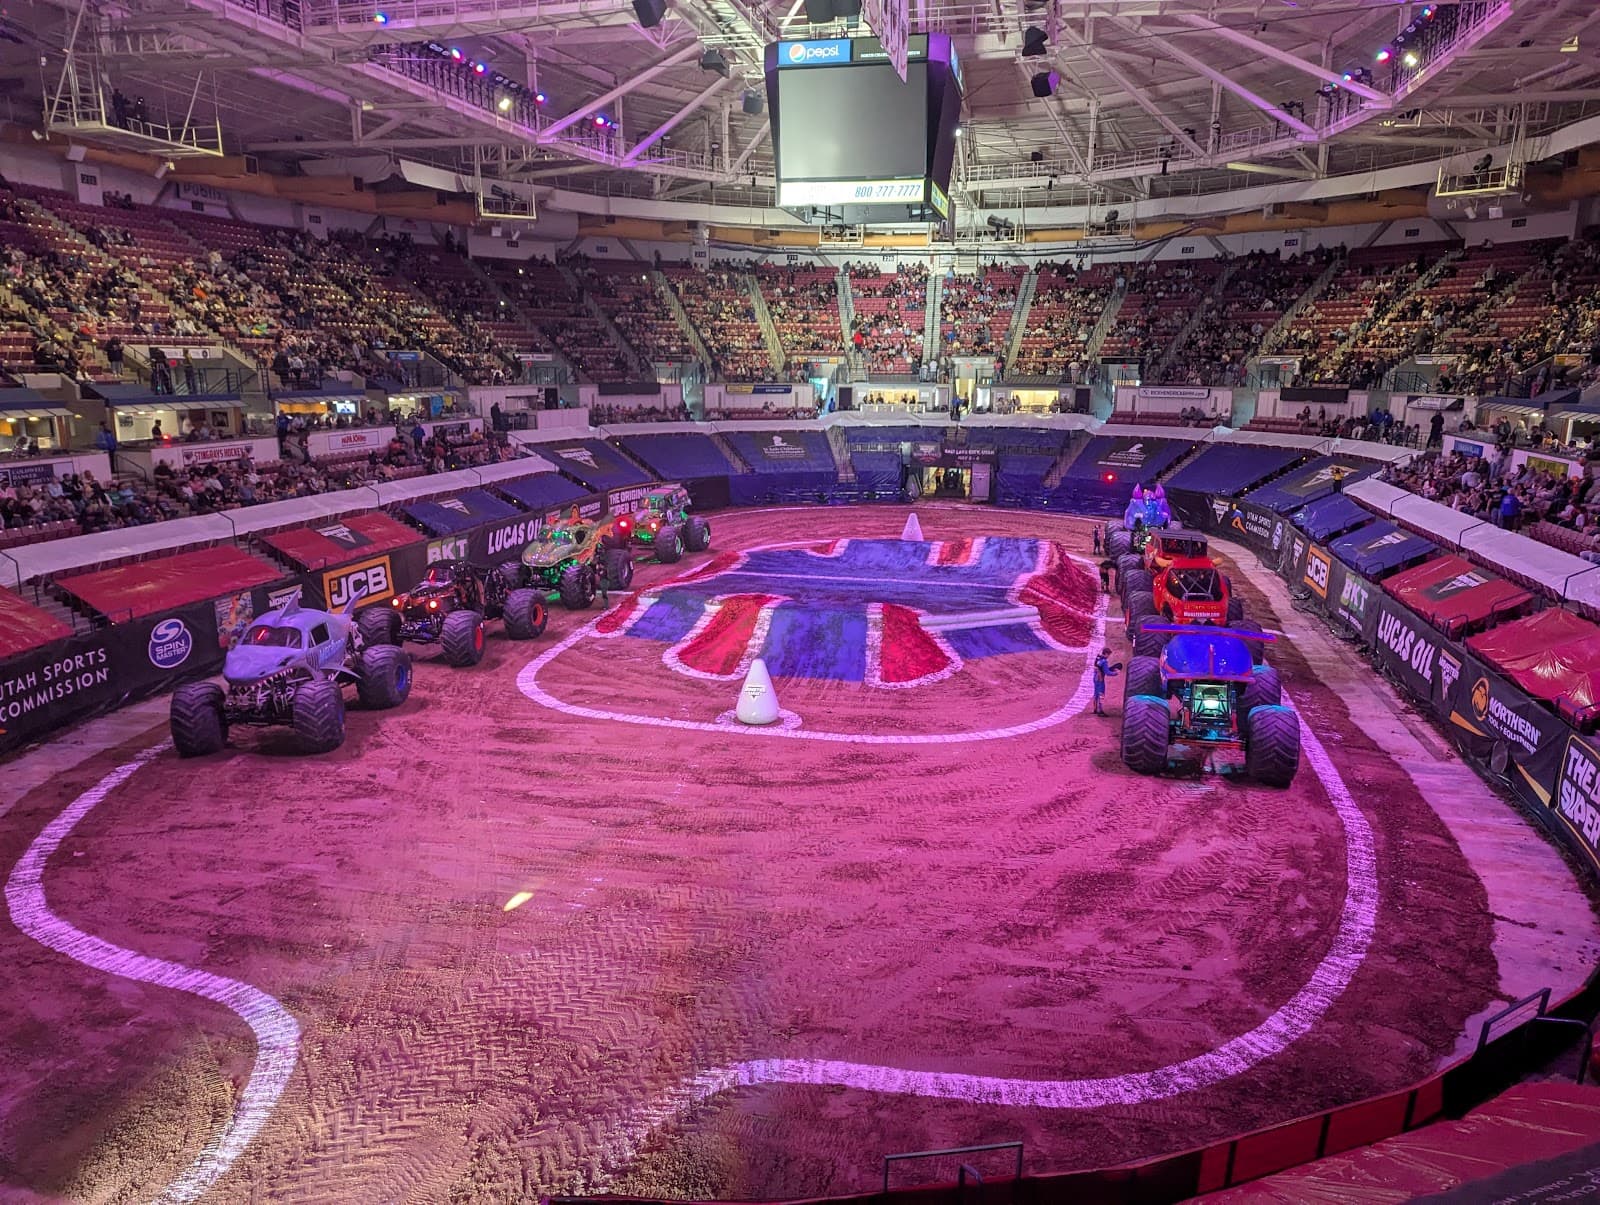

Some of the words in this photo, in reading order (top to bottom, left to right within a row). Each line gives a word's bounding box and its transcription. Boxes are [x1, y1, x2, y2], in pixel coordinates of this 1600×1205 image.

[806, 44, 839, 59] pepsi
[427, 538, 468, 566] BKT
[487, 521, 526, 555] LUCAS
[331, 565, 388, 606] JCB
[1307, 555, 1328, 588] JCB
[1342, 577, 1369, 612] BKT
[155, 639, 185, 655] SPIN
[1377, 609, 1416, 662] LUCAS
[1411, 638, 1435, 681] OIL
[43, 648, 106, 681] SPORTS
[0, 668, 108, 722] COMMISSION
[1488, 697, 1539, 746] NORTHERN
[1566, 746, 1597, 795] THE
